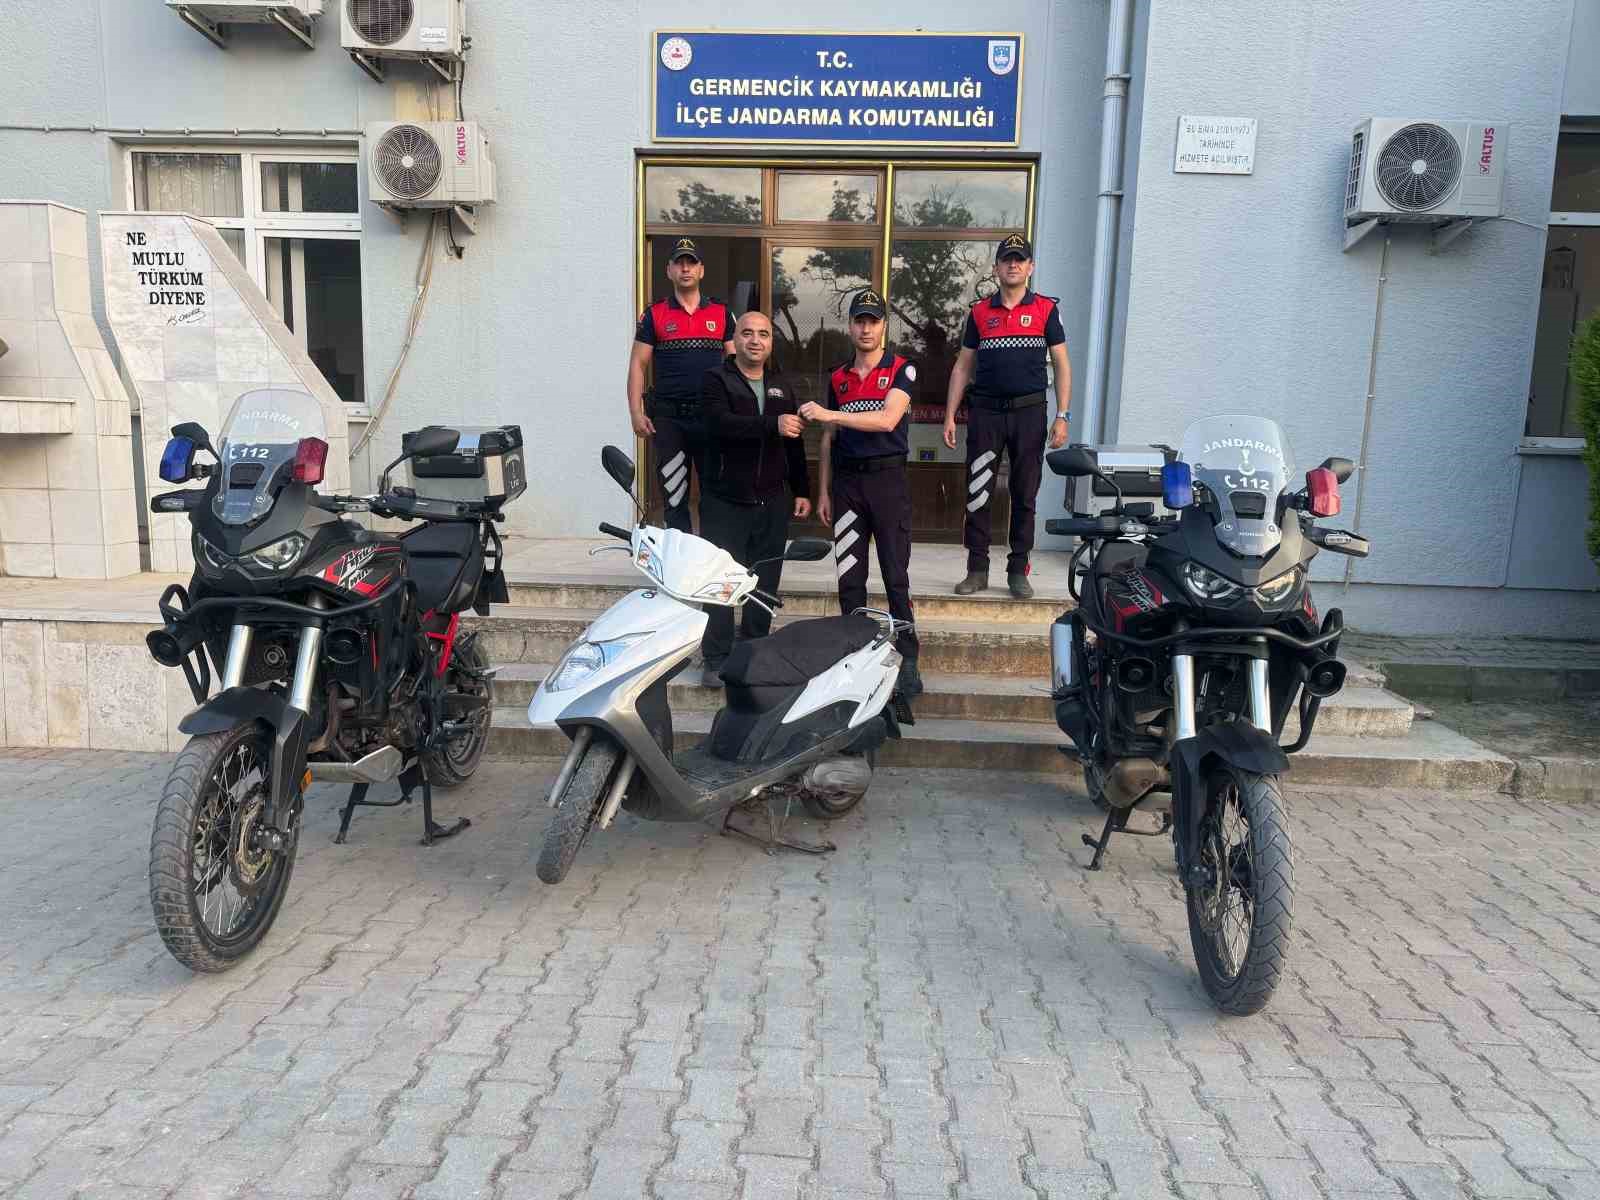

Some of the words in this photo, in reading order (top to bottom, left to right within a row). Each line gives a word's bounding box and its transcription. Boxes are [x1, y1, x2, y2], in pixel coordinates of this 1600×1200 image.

[816, 51, 853, 68] T.C.
[690, 76, 814, 97] GERMENCİK
[820, 77, 982, 98] KAYMAKAMLIĞI
[676, 102, 722, 128] İLÇE
[728, 107, 843, 126] JANDARMA
[850, 106, 994, 127] KOMUTANLIĞI
[456, 126, 465, 157] ALTUS
[1481, 128, 1495, 163] ALTUS
[126, 232, 147, 246] NE
[132, 252, 184, 266] MUTLU
[149, 287, 206, 305] DİYENE
[239, 447, 270, 459] 112
[1203, 438, 1284, 460] JANDARMA
[1240, 477, 1270, 490] 112
